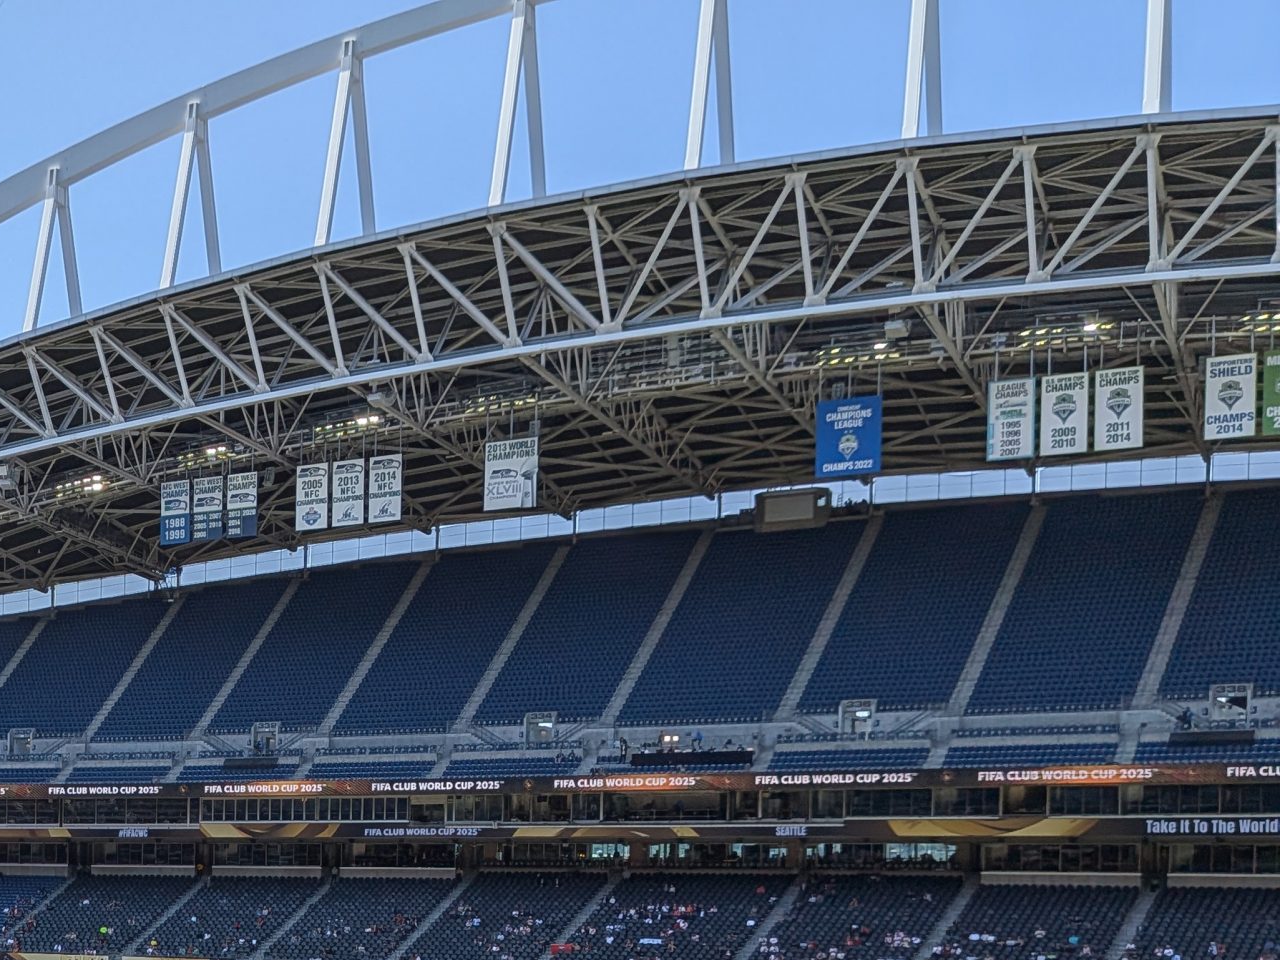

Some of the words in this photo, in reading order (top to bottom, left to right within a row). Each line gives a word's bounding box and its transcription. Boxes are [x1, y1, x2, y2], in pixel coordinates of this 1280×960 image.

[1210, 365, 1252, 378] SHIELD
[1099, 375, 1139, 387] CHAMPS
[997, 382, 1026, 392] LEAGUE
[1045, 381, 1084, 393] CHAMPS
[995, 390, 1028, 399] CHAMPS
[826, 409, 872, 422] CHAMPIONS
[1207, 412, 1254, 425] CHAMPS
[834, 419, 863, 429] LEAGUE
[1106, 422, 1130, 432] 2011
[1216, 424, 1243, 434] 2014
[1051, 427, 1076, 438] 2009
[1106, 433, 1131, 443] 2014
[488, 443, 507, 453] 2013
[509, 440, 535, 450] WORLD
[1051, 438, 1076, 449] 2010
[488, 449, 535, 462] CHAMPIONS
[823, 461, 853, 472] CHAMPS
[854, 459, 873, 469] 2022
[338, 475, 359, 486] 2013
[375, 471, 396, 482] 2014
[229, 481, 256, 491] CHAMPS
[302, 479, 322, 490] 2005
[378, 482, 393, 491] NFC
[162, 489, 188, 499] CHAMPS
[195, 485, 222, 495] CHAMPS
[304, 490, 319, 498] NFC
[341, 486, 355, 495] NFC
[370, 490, 400, 499] CHAMPIONS
[487, 484, 521, 496] XLVIII
[297, 498, 327, 506] CHAMPIONS
[333, 494, 363, 502] CHAMPIONS
[165, 518, 185, 528] 1988
[165, 530, 185, 540] 1999
[978, 771, 1005, 782] FIFA
[1007, 770, 1038, 781] CLUB
[1041, 769, 1088, 780] WORLD
[1091, 769, 1117, 780] CUP
[1227, 766, 1256, 777] FIFA
[1259, 765, 1280, 777] CLU
[554, 779, 576, 789] FIFA
[577, 778, 604, 788] CLUB
[605, 777, 644, 787] WORLD
[645, 777, 667, 786] CUP
[755, 775, 779, 785] FIFA
[781, 775, 810, 785] CLUB
[812, 774, 854, 784] WORLD
[856, 773, 880, 783] CUP
[48, 787, 66, 795] FIFA
[67, 786, 88, 795] CLUB
[88, 786, 119, 795] WORLD
[120, 786, 137, 795] CUP
[205, 785, 223, 794] FIFA
[224, 784, 247, 793] CLUB
[247, 784, 279, 793] WORLD
[280, 784, 297, 793] CUP
[371, 782, 391, 791] FIFA
[392, 781, 417, 791] CLUB
[419, 781, 454, 791] WORLD
[455, 781, 474, 790] CUP
[1146, 819, 1176, 833] Take
[1180, 819, 1189, 832] It
[1193, 819, 1209, 832] To
[1212, 819, 1235, 832] The
[1239, 818, 1279, 833] World
[775, 826, 808, 836] SEATTLE
